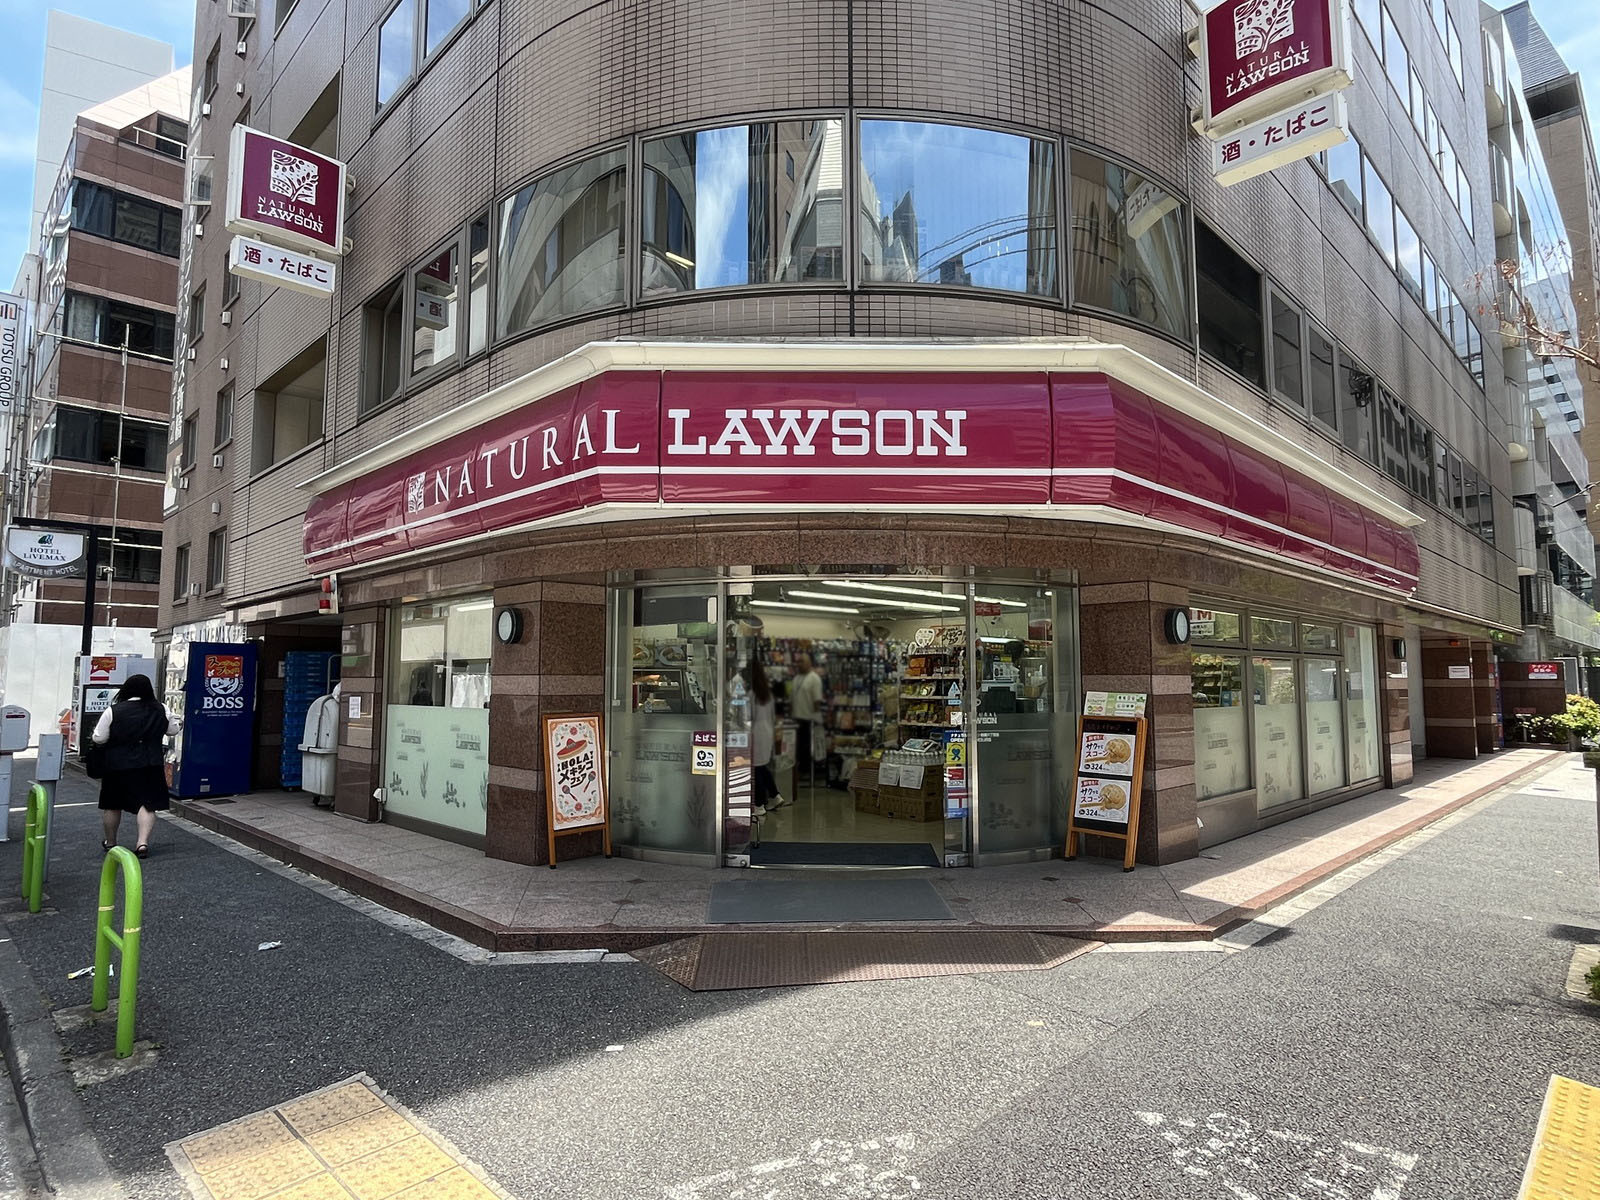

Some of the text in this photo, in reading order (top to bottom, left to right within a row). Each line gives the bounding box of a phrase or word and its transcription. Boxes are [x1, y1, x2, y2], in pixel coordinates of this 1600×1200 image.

[1226, 40, 1310, 85] NATURAL
[1226, 49, 1310, 98] LAWSON
[1222, 106, 1329, 164] 酒・たばこ
[257, 203, 324, 234] LAWSON
[258, 196, 324, 224] NATURAL
[244, 245, 328, 283] 酒・たばこ
[0, 327, 15, 407] TOTSU GROUP
[433, 409, 968, 506] NATURAL LAWSON
[30, 547, 62, 555] HOTEL
[55, 565, 79, 575] HOTEL
[203, 696, 244, 709] BOSS
[694, 734, 716, 743] たばこ
[1086, 750, 1109, 758] スコーン
[558, 760, 594, 785] メキシコ
[570, 773, 587, 786] フェア
